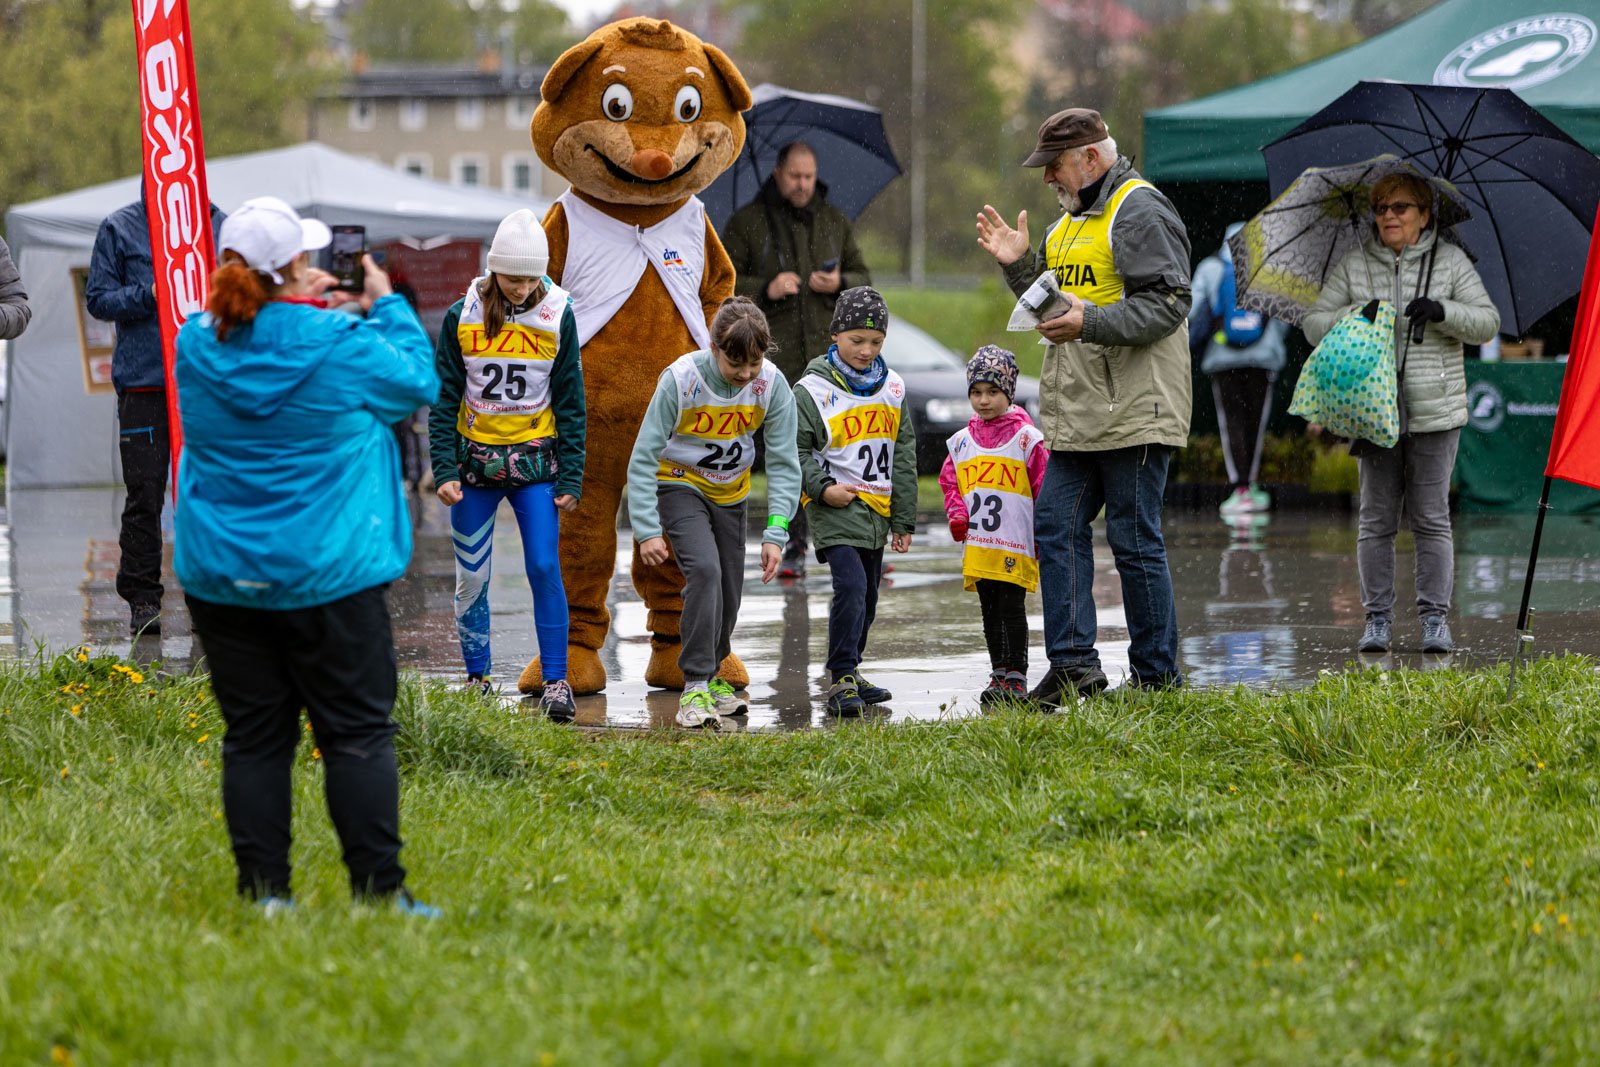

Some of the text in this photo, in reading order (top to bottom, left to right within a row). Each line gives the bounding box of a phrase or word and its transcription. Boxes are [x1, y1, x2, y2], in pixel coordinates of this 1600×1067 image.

[663, 248, 680, 261] dm
[1047, 264, 1098, 287] DZIA
[470, 329, 541, 354] DZN
[481, 363, 527, 401] 25
[692, 411, 753, 435] DZN
[843, 410, 896, 440] DZN
[696, 441, 743, 471] 22
[858, 443, 890, 482] 24
[963, 461, 1021, 489] DZN
[968, 492, 1003, 532] 23
[966, 533, 994, 544] Związek
